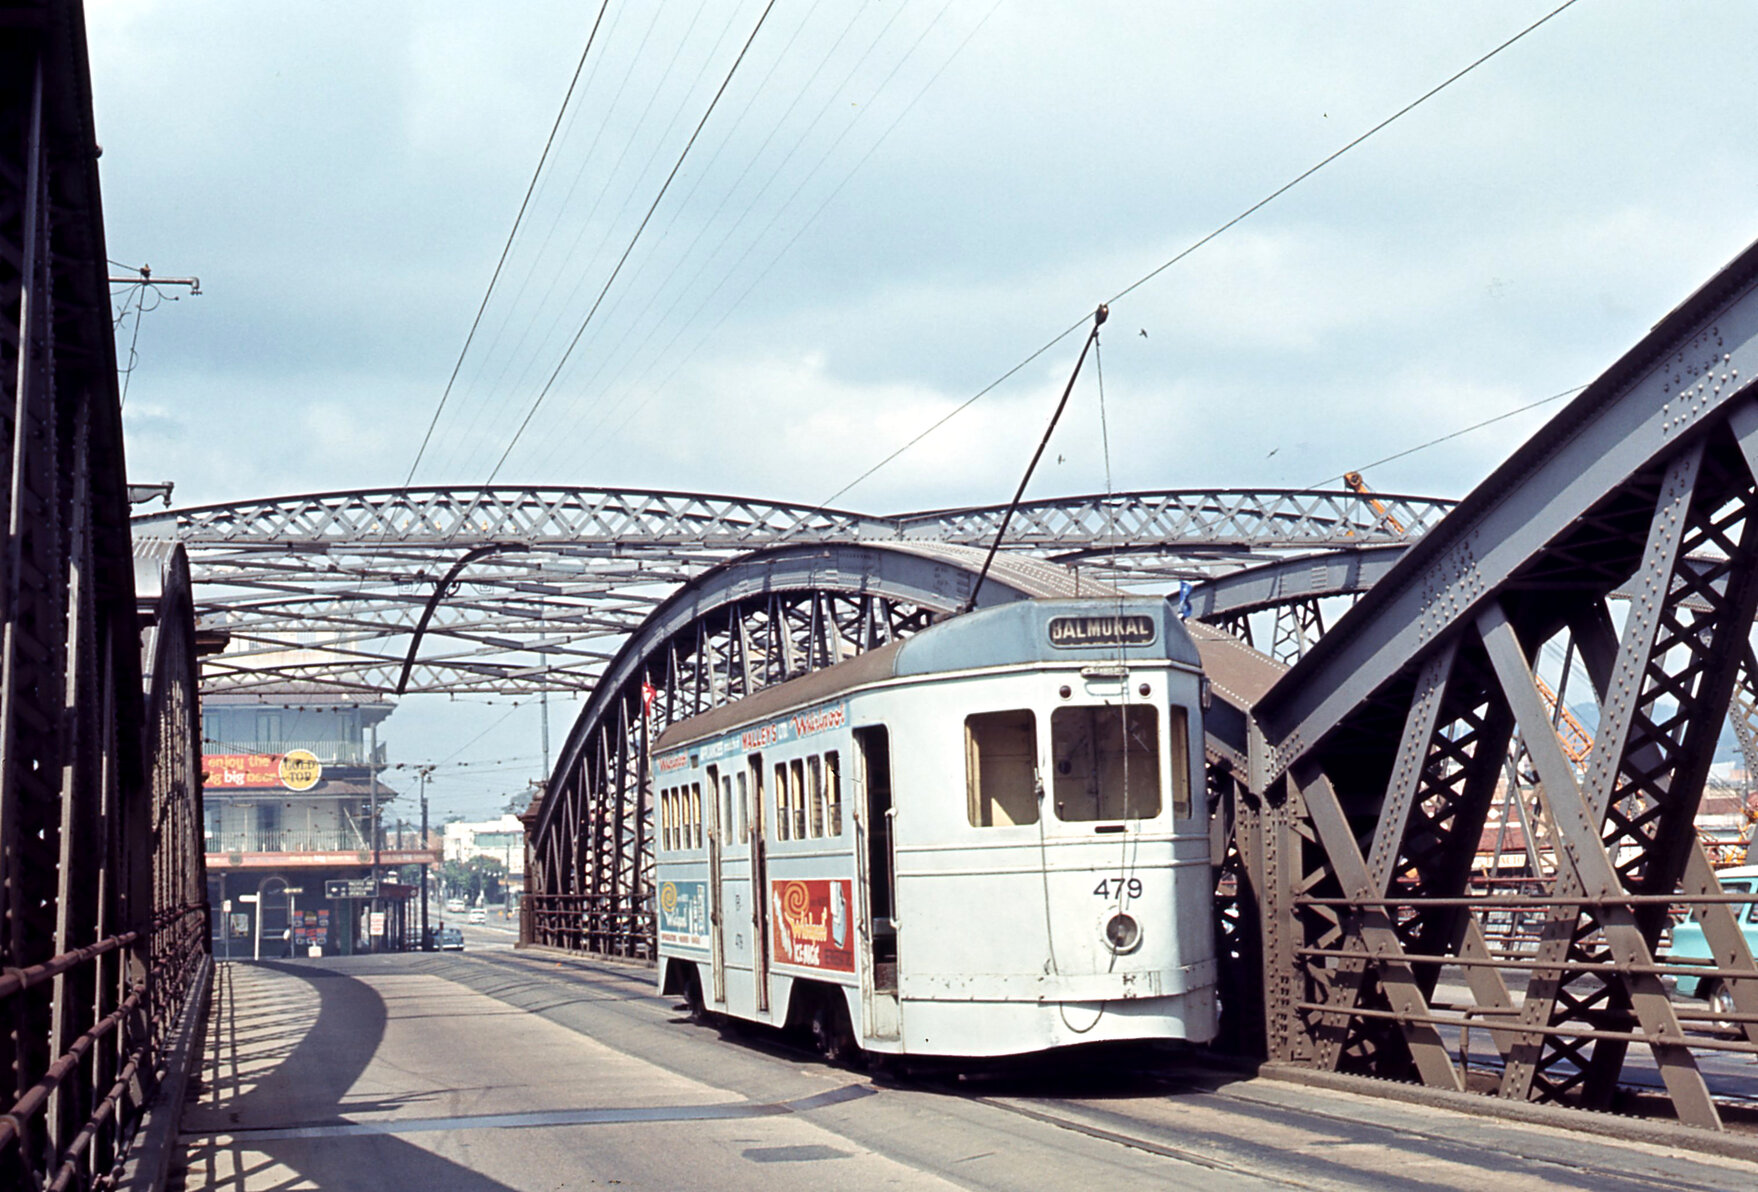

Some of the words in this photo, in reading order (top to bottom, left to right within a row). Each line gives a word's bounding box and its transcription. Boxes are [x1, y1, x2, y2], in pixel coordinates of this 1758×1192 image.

[208, 755, 244, 769] enjoy
[248, 754, 270, 767] the
[224, 769, 245, 785] big
[1093, 878, 1142, 900] 479
